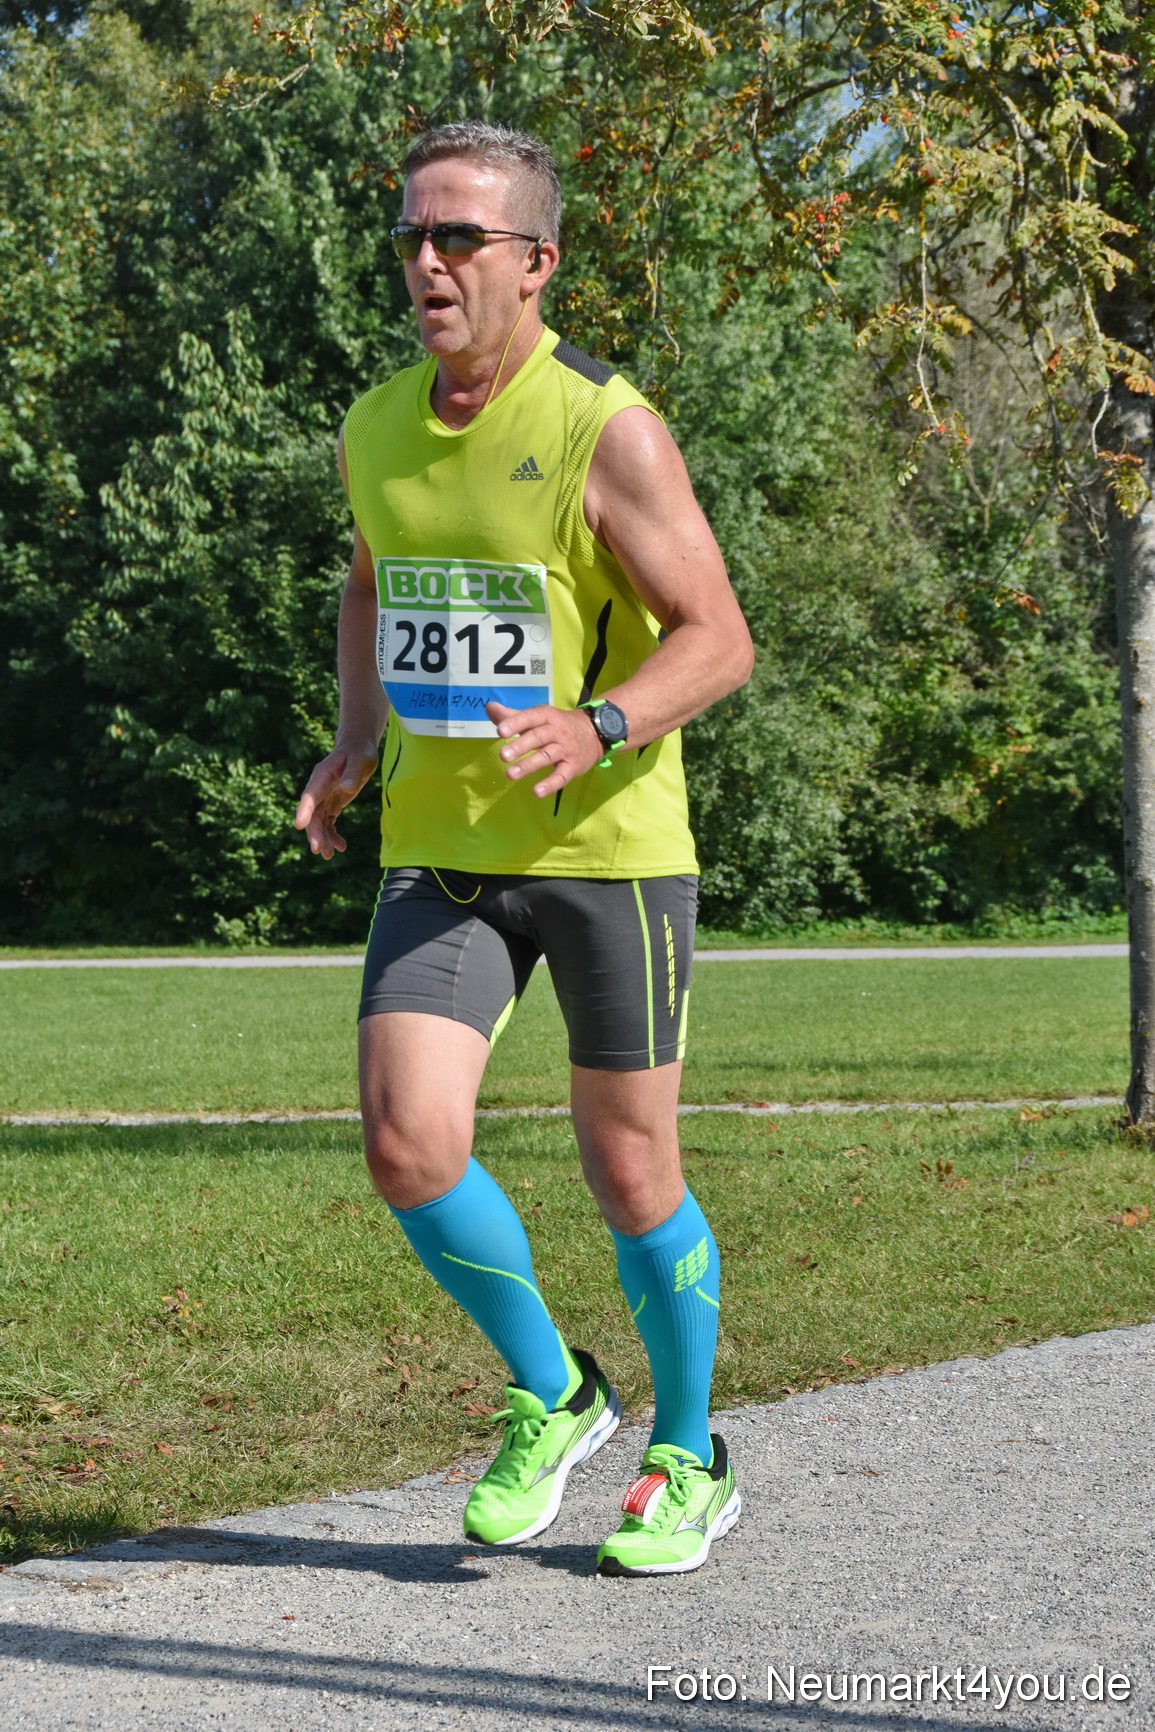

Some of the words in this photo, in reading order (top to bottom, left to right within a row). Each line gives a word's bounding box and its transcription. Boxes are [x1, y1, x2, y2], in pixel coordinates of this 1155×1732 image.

[510, 471, 544, 481] adidas
[387, 567, 531, 606] BOCK
[393, 620, 526, 675] 2812
[409, 689, 491, 710] HERMANN
